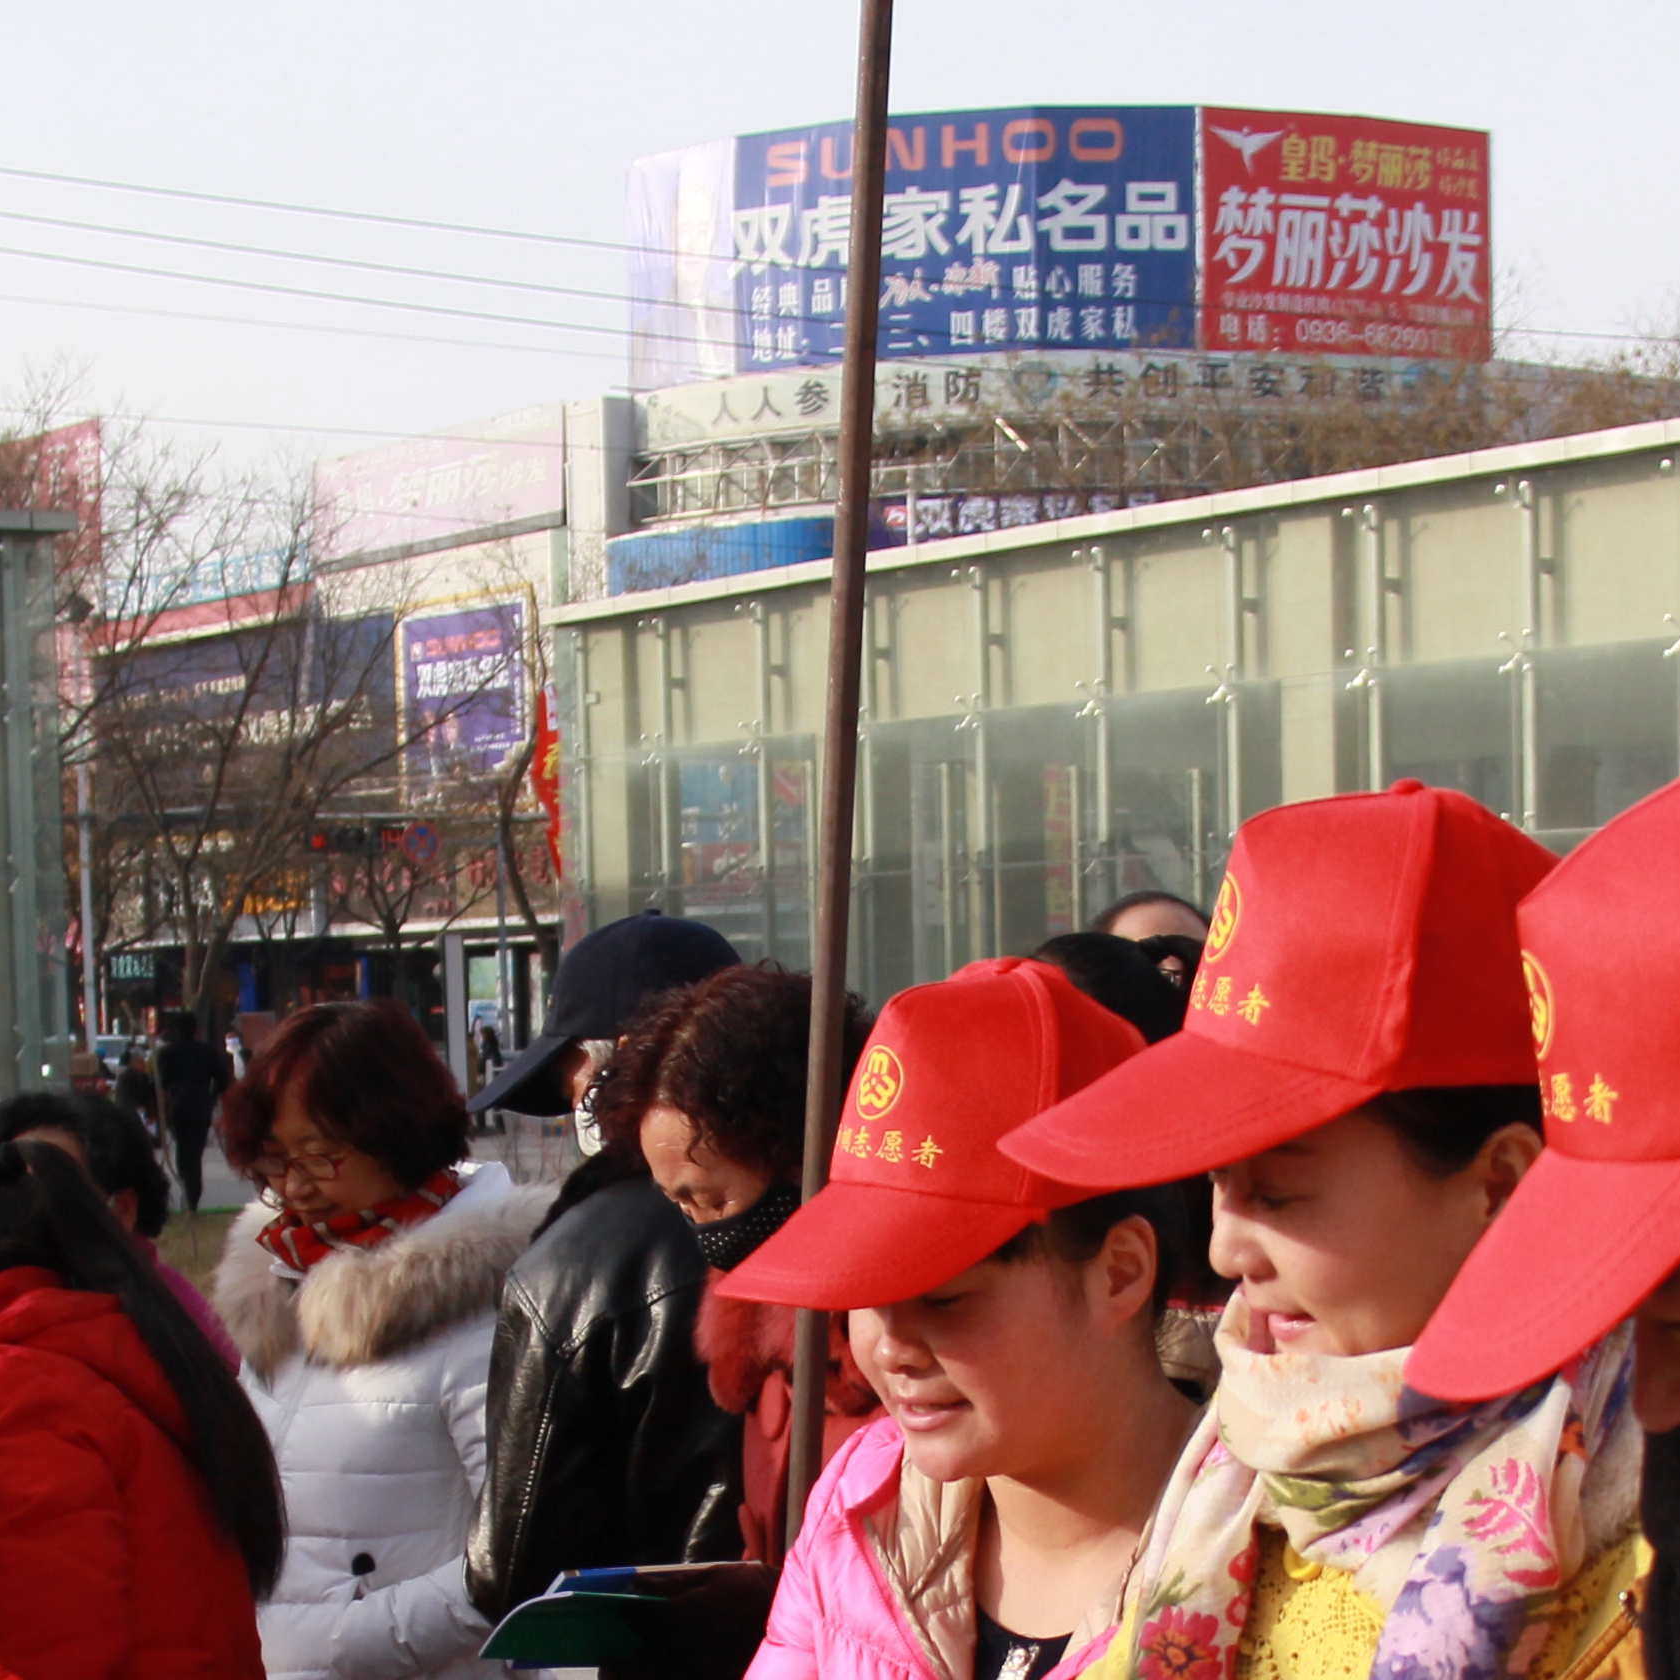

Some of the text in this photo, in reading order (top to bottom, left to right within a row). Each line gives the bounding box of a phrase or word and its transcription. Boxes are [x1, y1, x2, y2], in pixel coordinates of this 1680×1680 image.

[766, 117, 1125, 188] SUNHOO
[726, 178, 1189, 280] 双虎家私名品
[1212, 184, 1483, 304] 梦丽莎沙发
[1012, 261, 1138, 301] 贴心服务
[711, 368, 983, 426] 人人参消防
